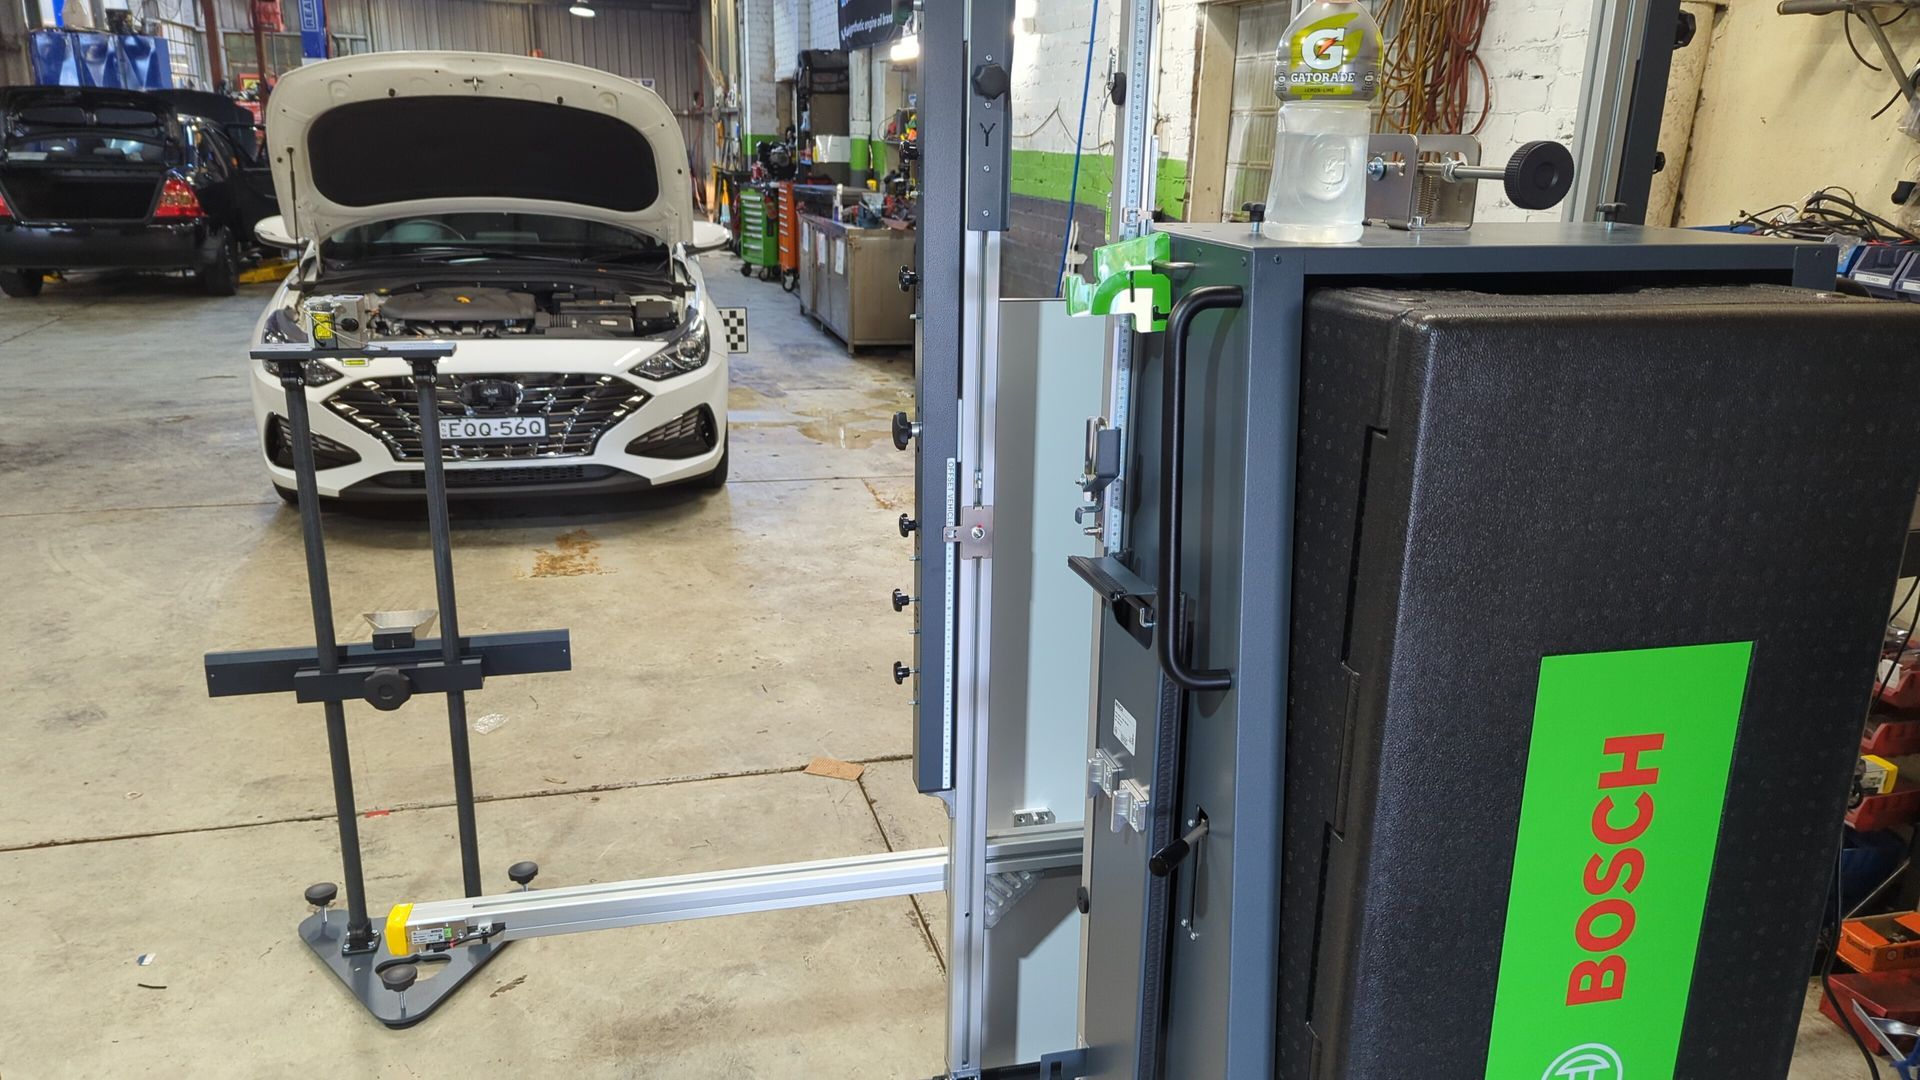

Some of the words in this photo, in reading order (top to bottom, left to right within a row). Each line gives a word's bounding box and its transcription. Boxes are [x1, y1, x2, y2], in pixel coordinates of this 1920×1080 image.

[304, 0, 313, 26] REA
[1302, 28, 1345, 70] G
[1291, 72, 1355, 83] GATORADE
[980, 122, 996, 147] Y
[1565, 733, 1665, 1006] BOSCH
